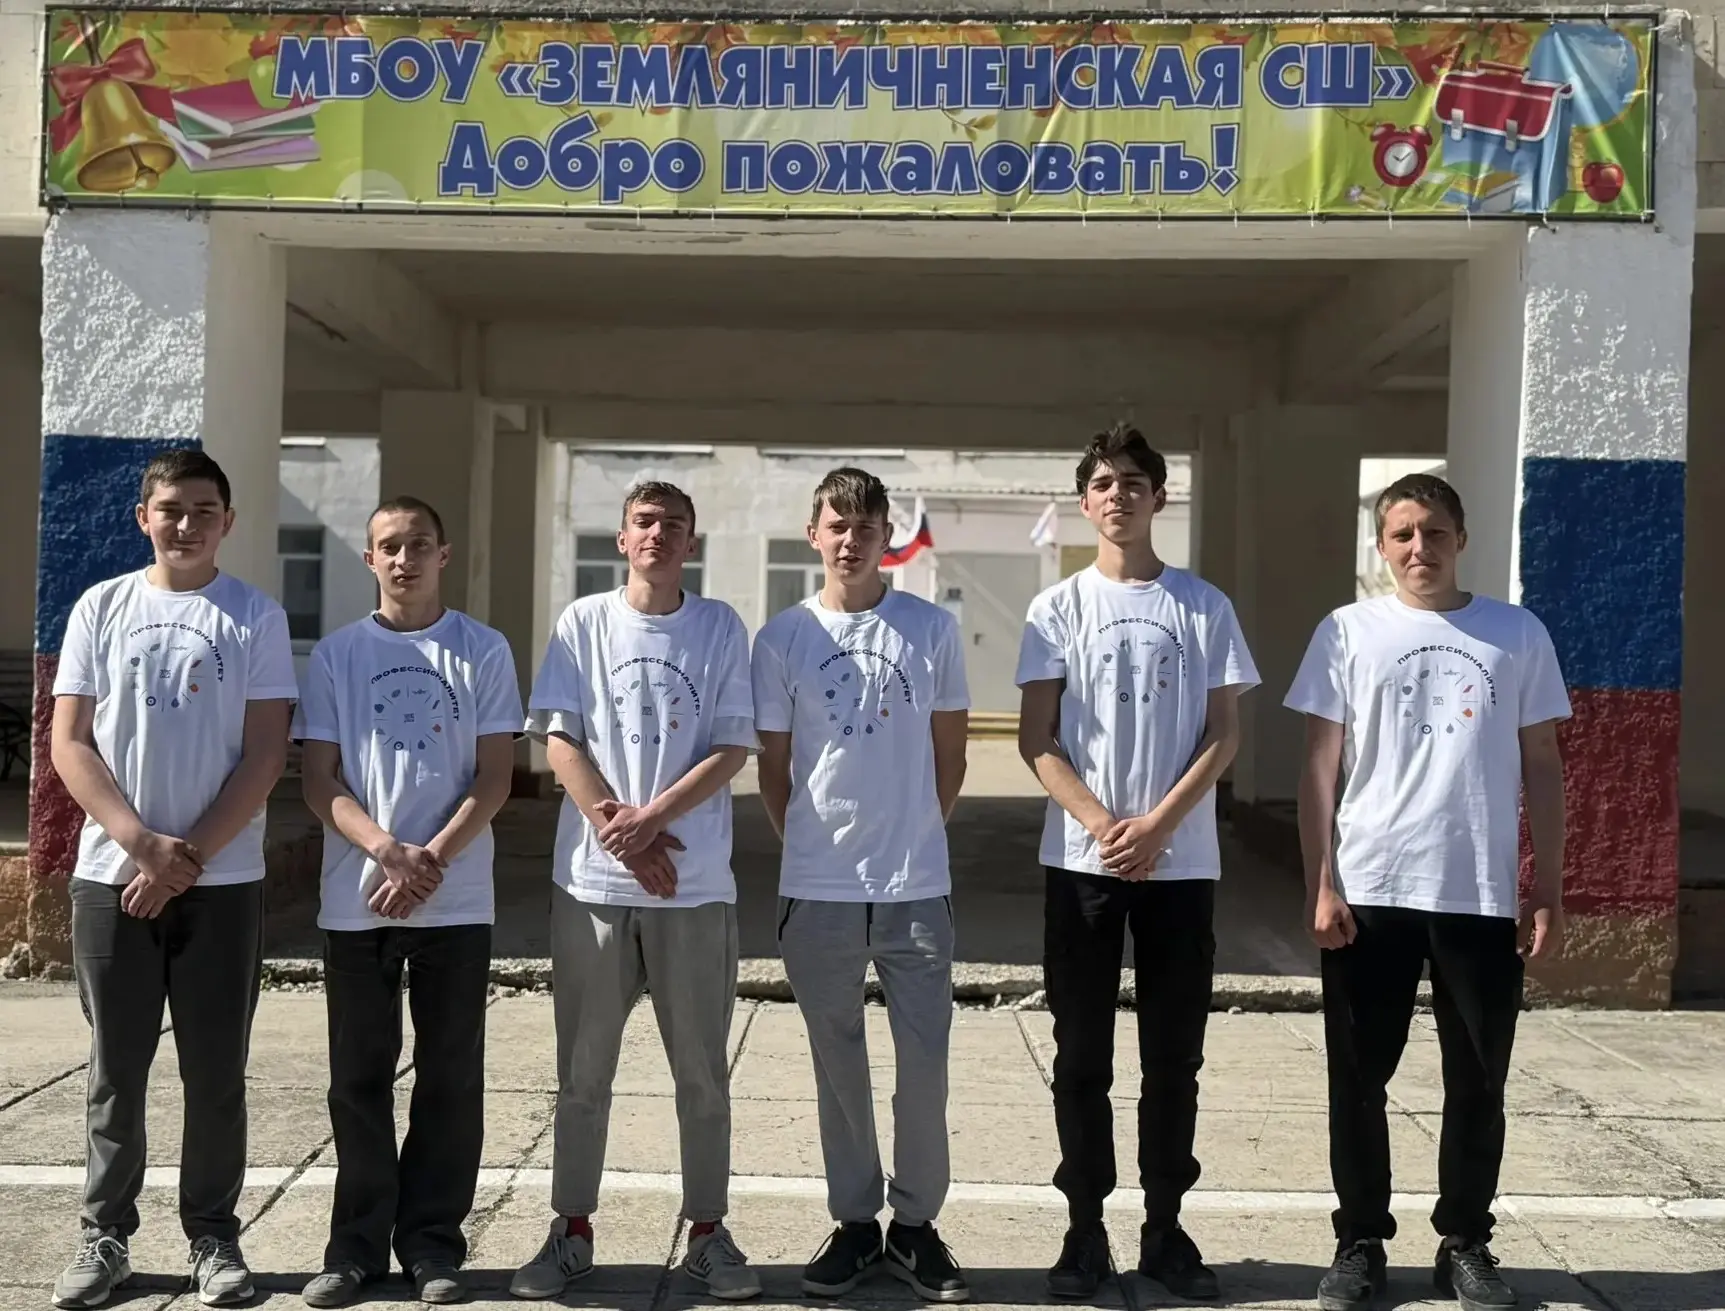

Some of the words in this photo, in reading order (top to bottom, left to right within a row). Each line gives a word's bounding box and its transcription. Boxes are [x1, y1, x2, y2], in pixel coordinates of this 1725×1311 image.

[272, 36, 487, 104] МБОУ
[496, 40, 1243, 112] «ЗЕМЛЯНИЧНЕНСКАЯ
[1258, 41, 1417, 109] СШ»
[437, 110, 704, 205] Добро
[721, 122, 1240, 197] пожаловать!
[129, 622, 224, 682] ПРОФЕССИОНАЛИТЕТ
[819, 649, 912, 704] ПРОФЕССИОНАЛИТЕТ
[1397, 645, 1497, 706] ПРОФЕССИОНАЛИТЕТ
[370, 666, 460, 721] ПРОФЕССИОНАЛИТЕТ
